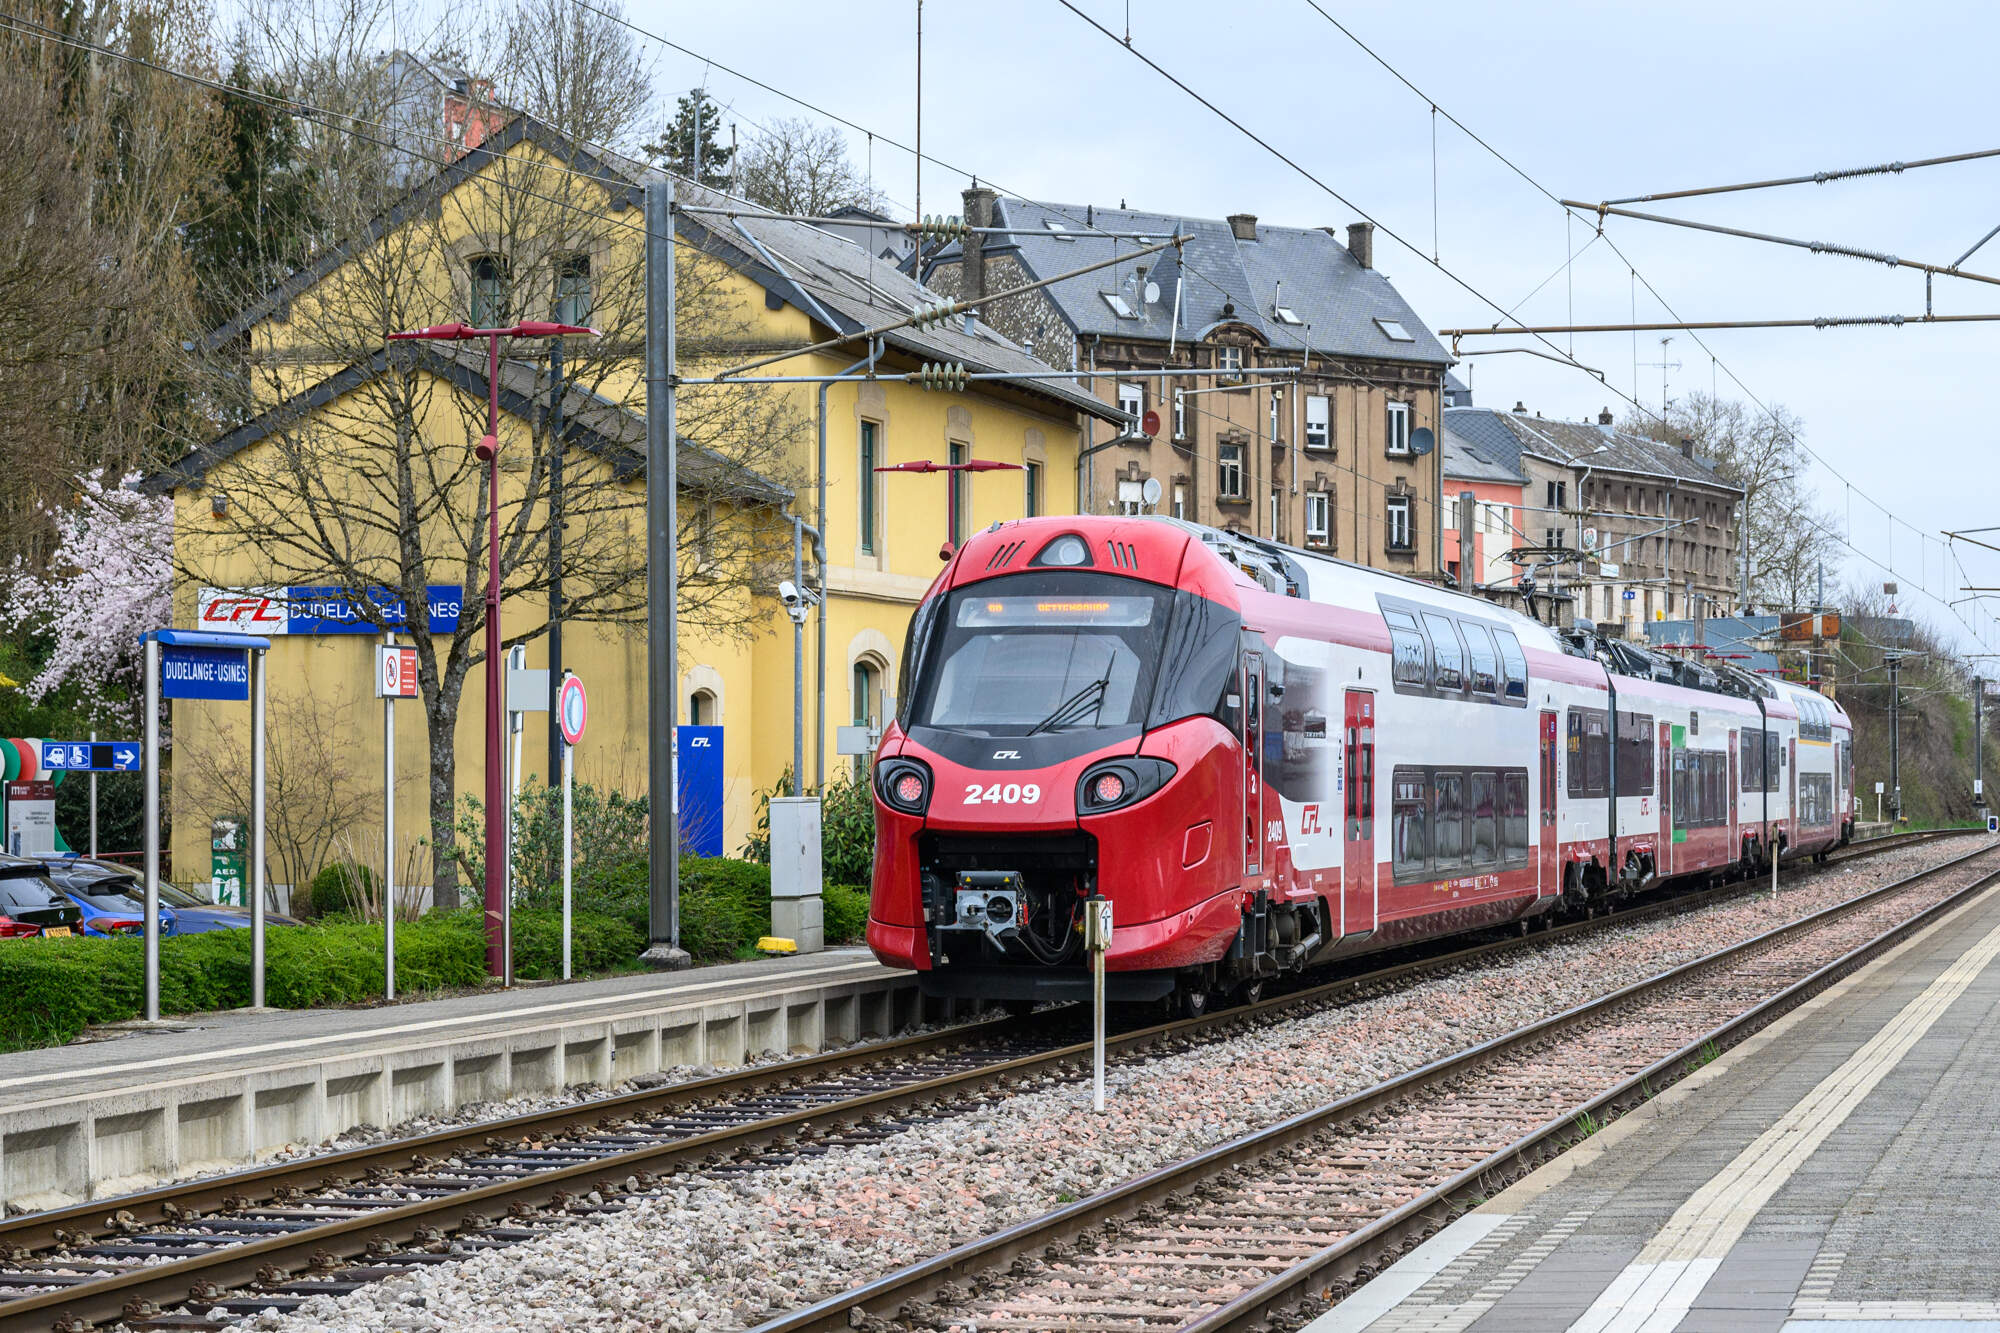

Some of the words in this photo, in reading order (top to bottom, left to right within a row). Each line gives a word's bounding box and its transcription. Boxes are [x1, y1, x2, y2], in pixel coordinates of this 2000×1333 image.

[203, 598, 282, 621] CFL
[165, 661, 247, 683] DUDELANGE-USINES
[691, 737, 711, 748] CFL
[992, 750, 1022, 760] CFL
[963, 783, 1041, 805] 2409
[1251, 774, 1256, 794] 2
[1301, 804, 1322, 835] CFL
[1267, 820, 1283, 842] 2409
